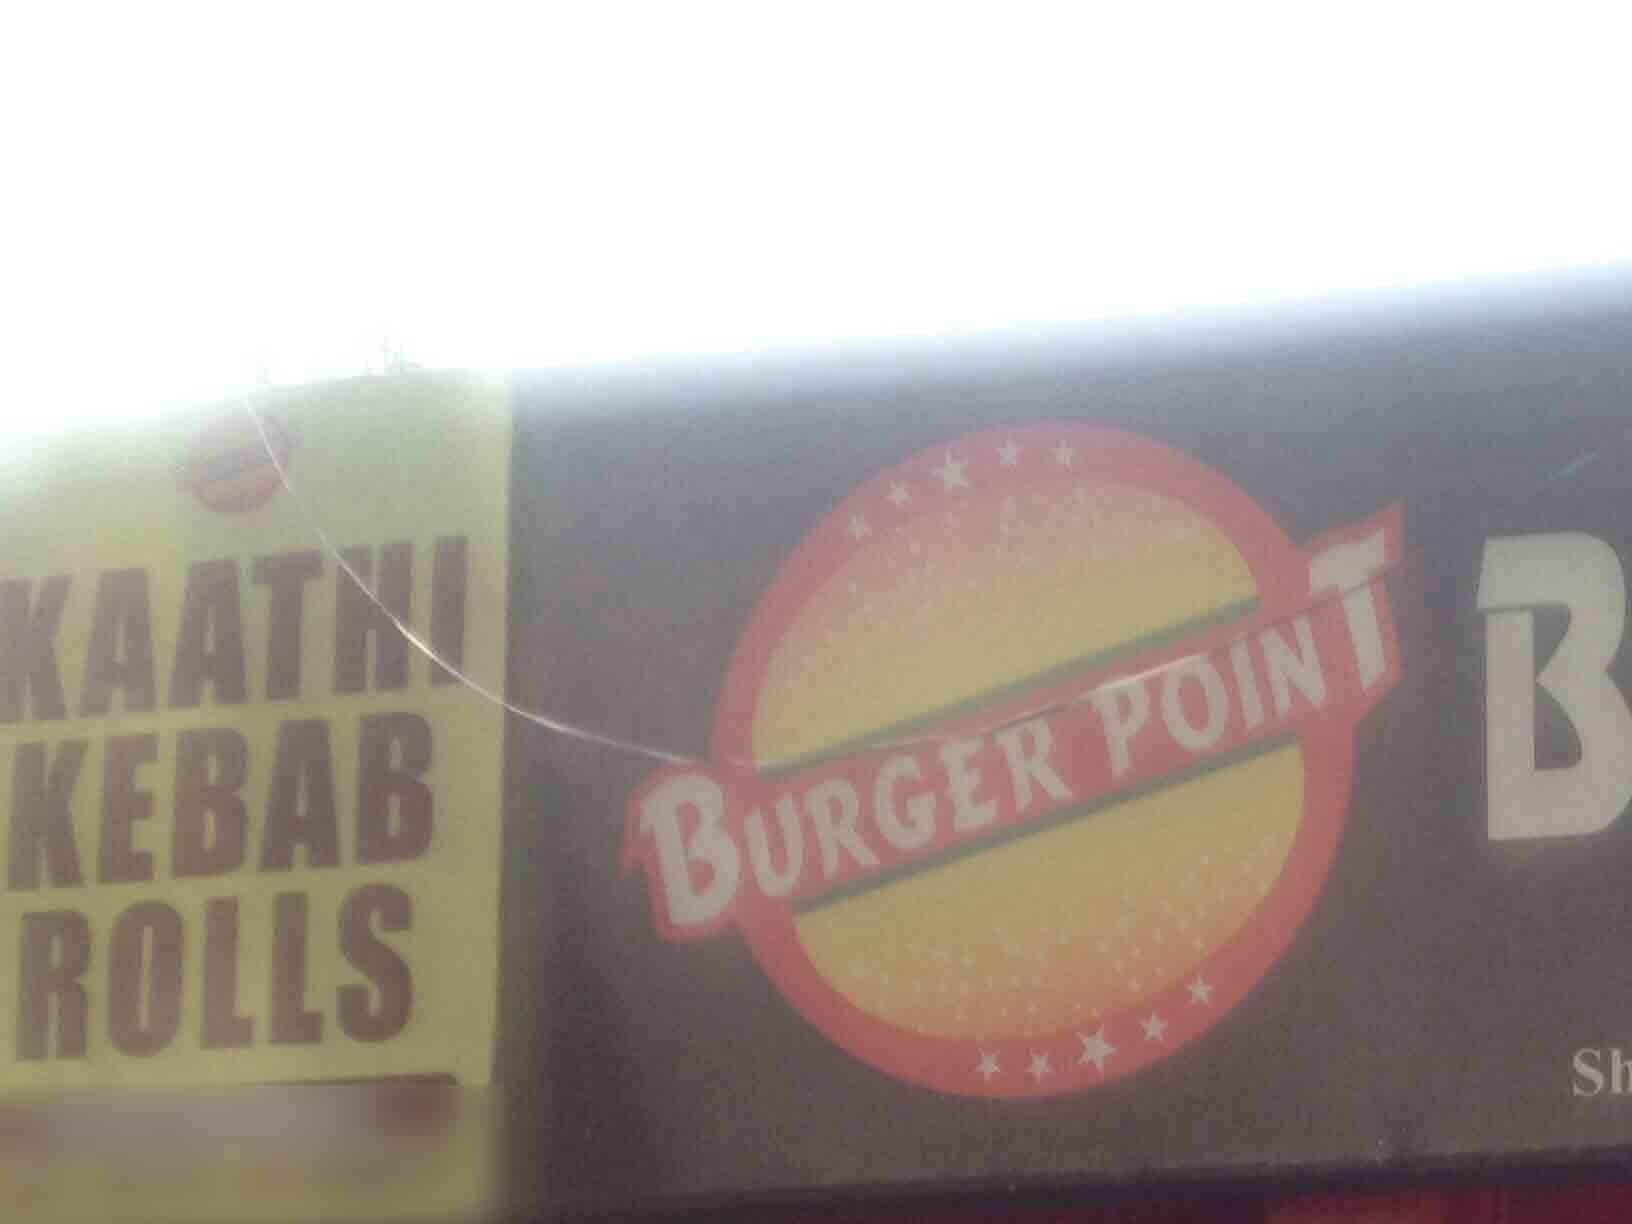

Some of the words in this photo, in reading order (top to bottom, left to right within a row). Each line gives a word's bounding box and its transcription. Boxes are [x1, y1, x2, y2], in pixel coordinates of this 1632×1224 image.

[0, 535, 469, 724] KAATHI
[8, 711, 435, 891] KEBAB
[640, 718, 1073, 928] BURGER
[1089, 528, 1388, 780] POINT
[15, 882, 415, 1062] ROLLS
